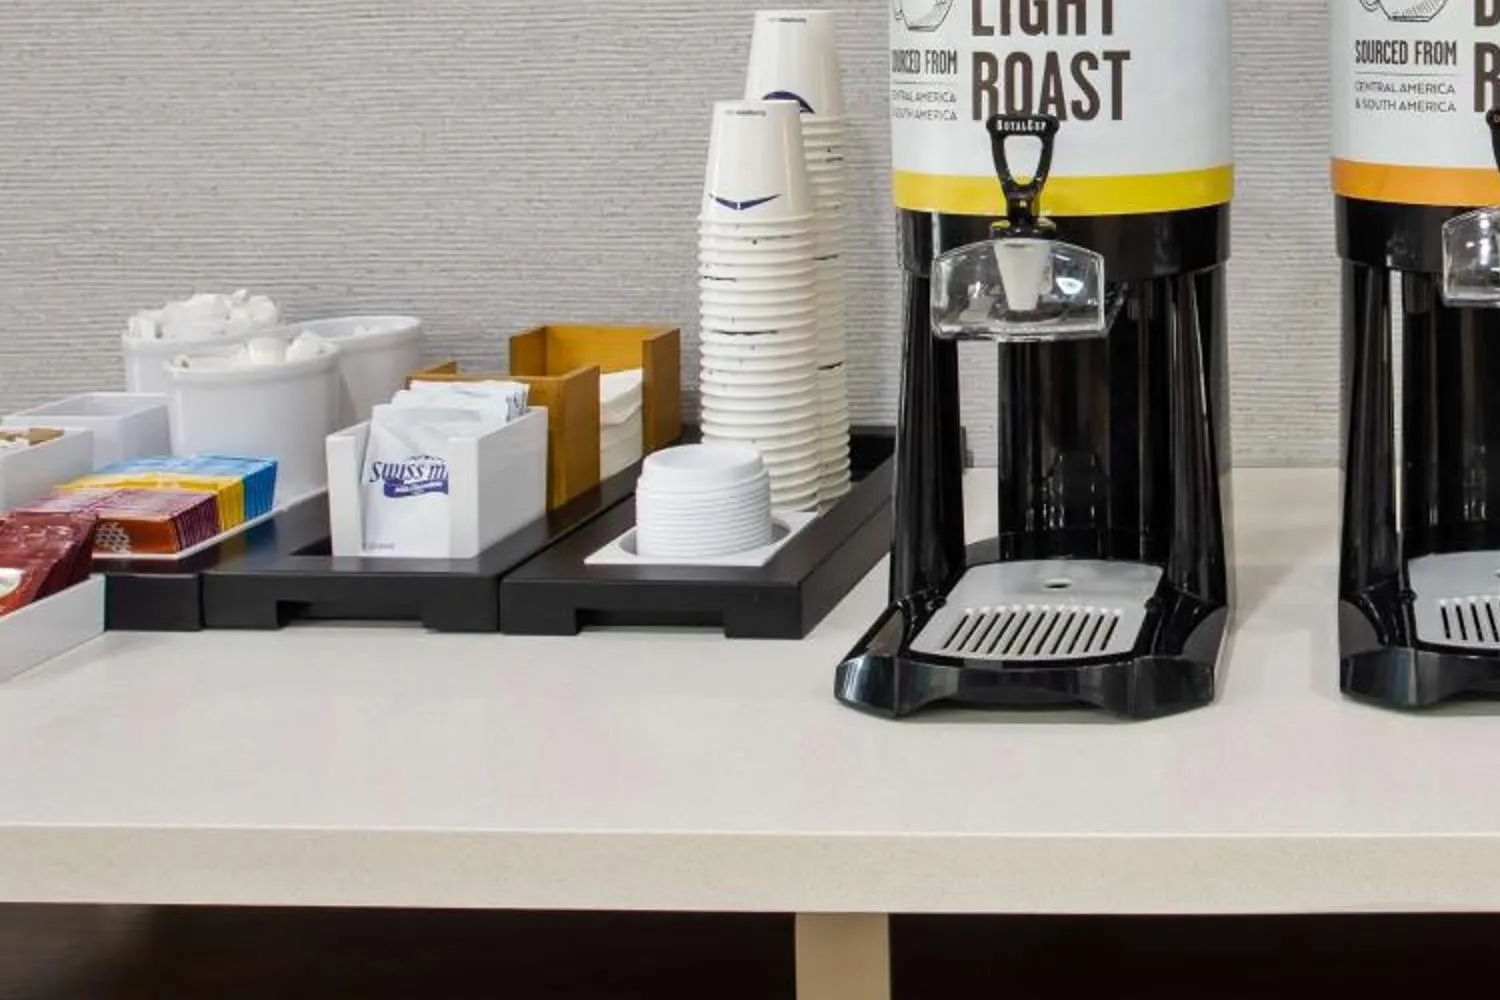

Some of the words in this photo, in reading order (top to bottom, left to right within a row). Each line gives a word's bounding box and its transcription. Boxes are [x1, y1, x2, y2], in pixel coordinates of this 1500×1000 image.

[925, 49, 958, 75] FROM
[1355, 39, 1409, 65] SOURCED
[1414, 39, 1458, 66] FROM
[972, 50, 1131, 121] ROAST
[1399, 82, 1456, 95] AMERICA
[1398, 100, 1457, 113] AMERICA
